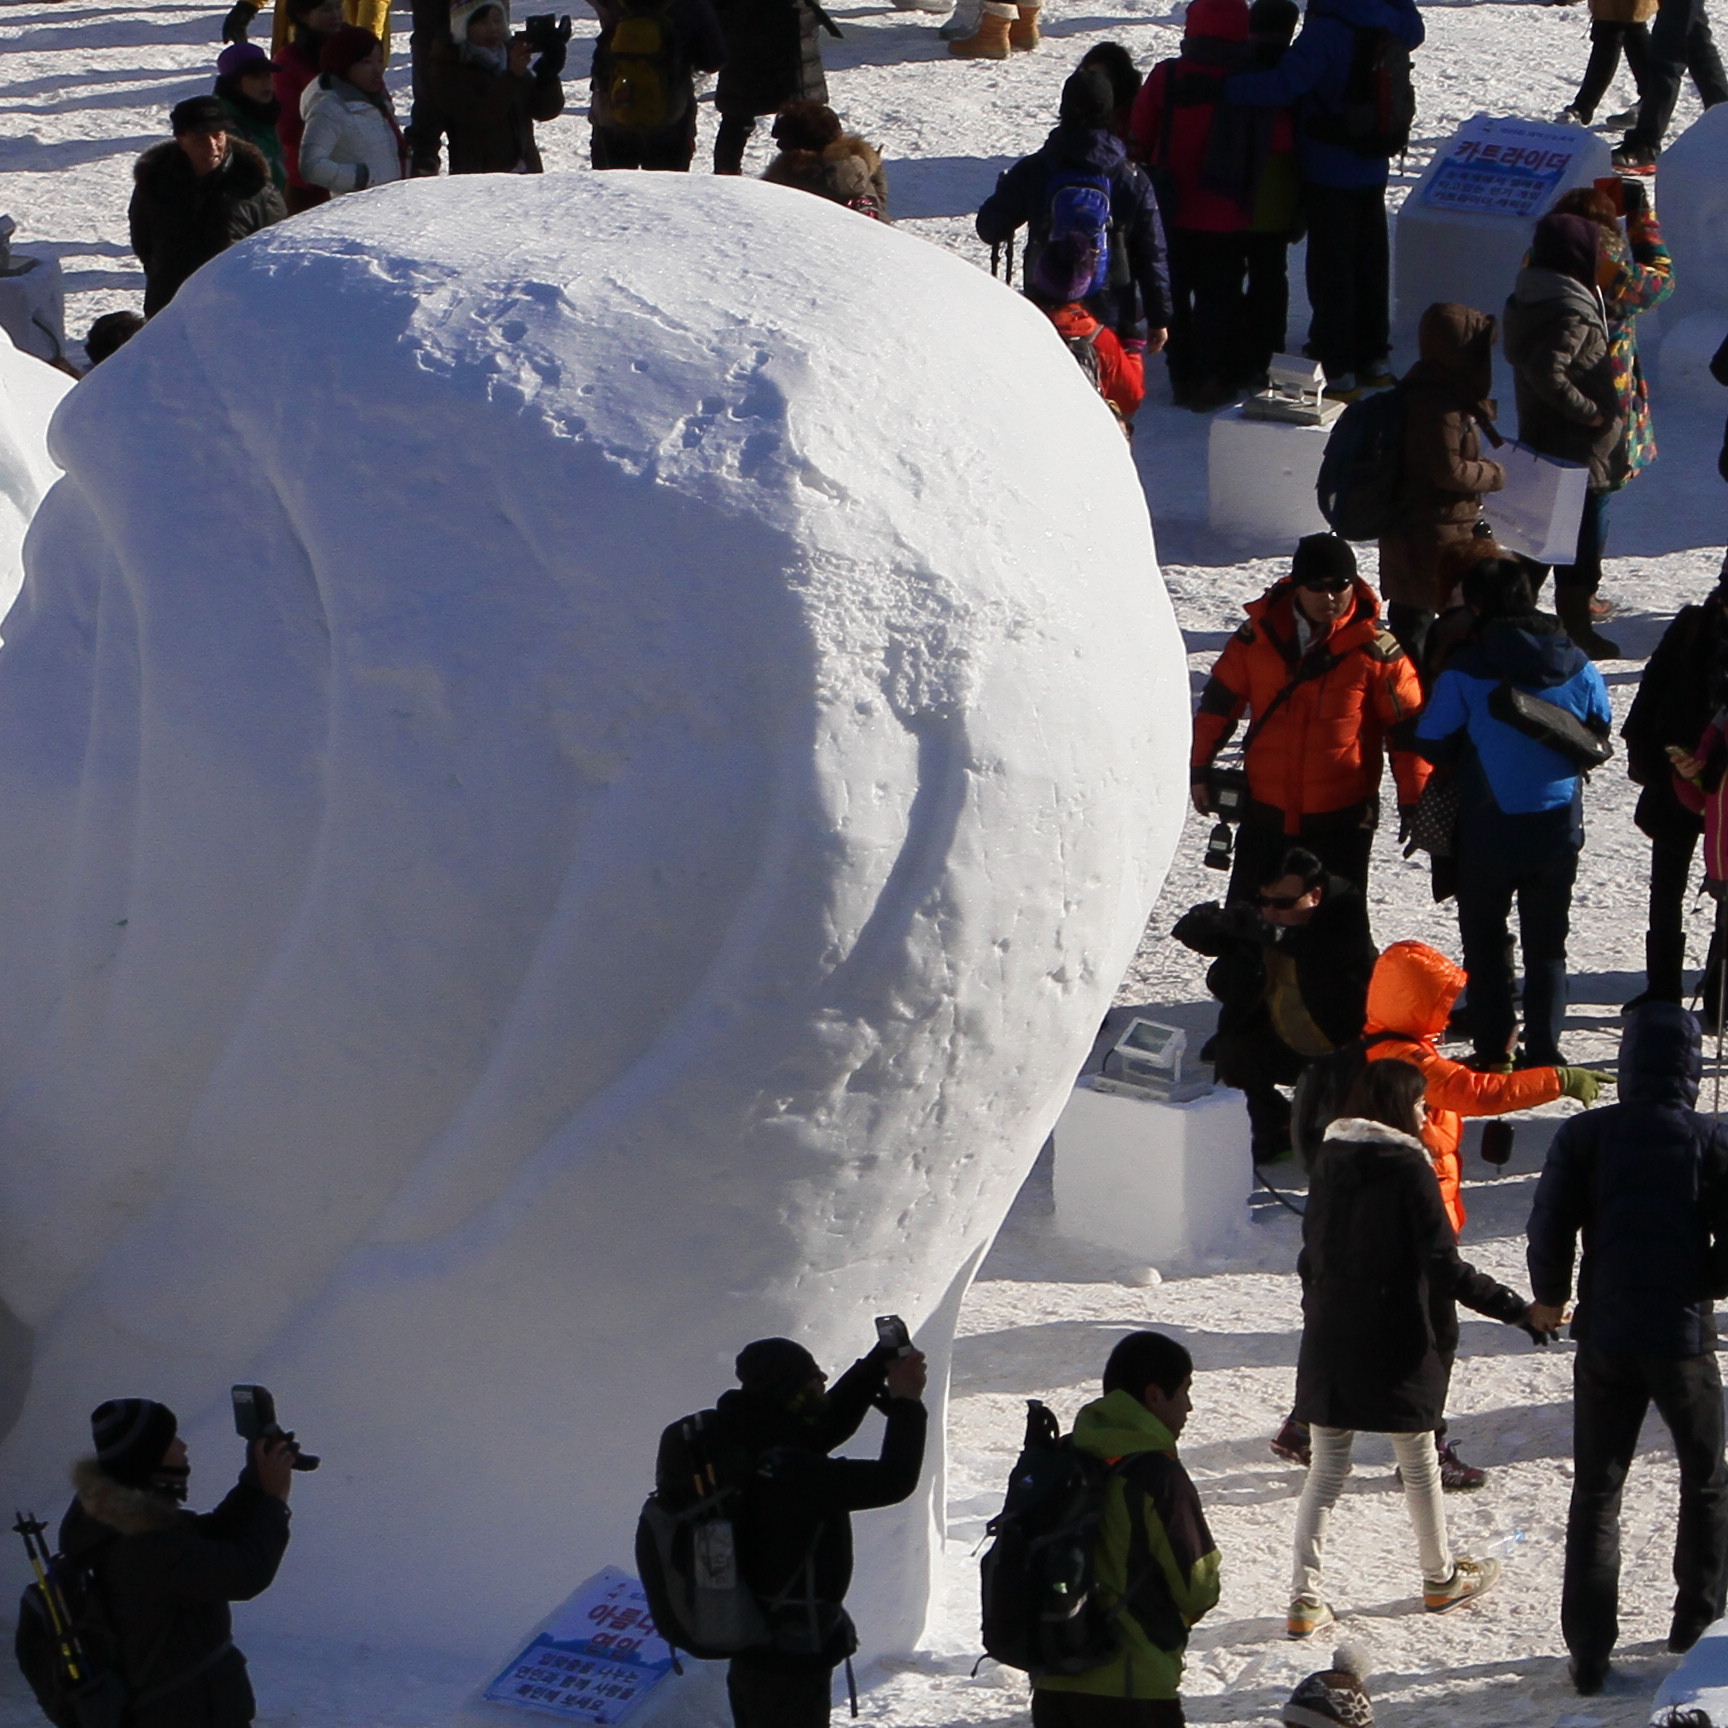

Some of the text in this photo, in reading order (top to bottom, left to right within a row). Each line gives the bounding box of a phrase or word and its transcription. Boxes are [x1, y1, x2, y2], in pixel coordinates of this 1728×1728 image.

[1454, 140, 1573, 171] 카트라이더
[586, 1632, 644, 1660] 연인
[599, 1666, 640, 1684] 나누는
[561, 1694, 604, 1711] 보세요
